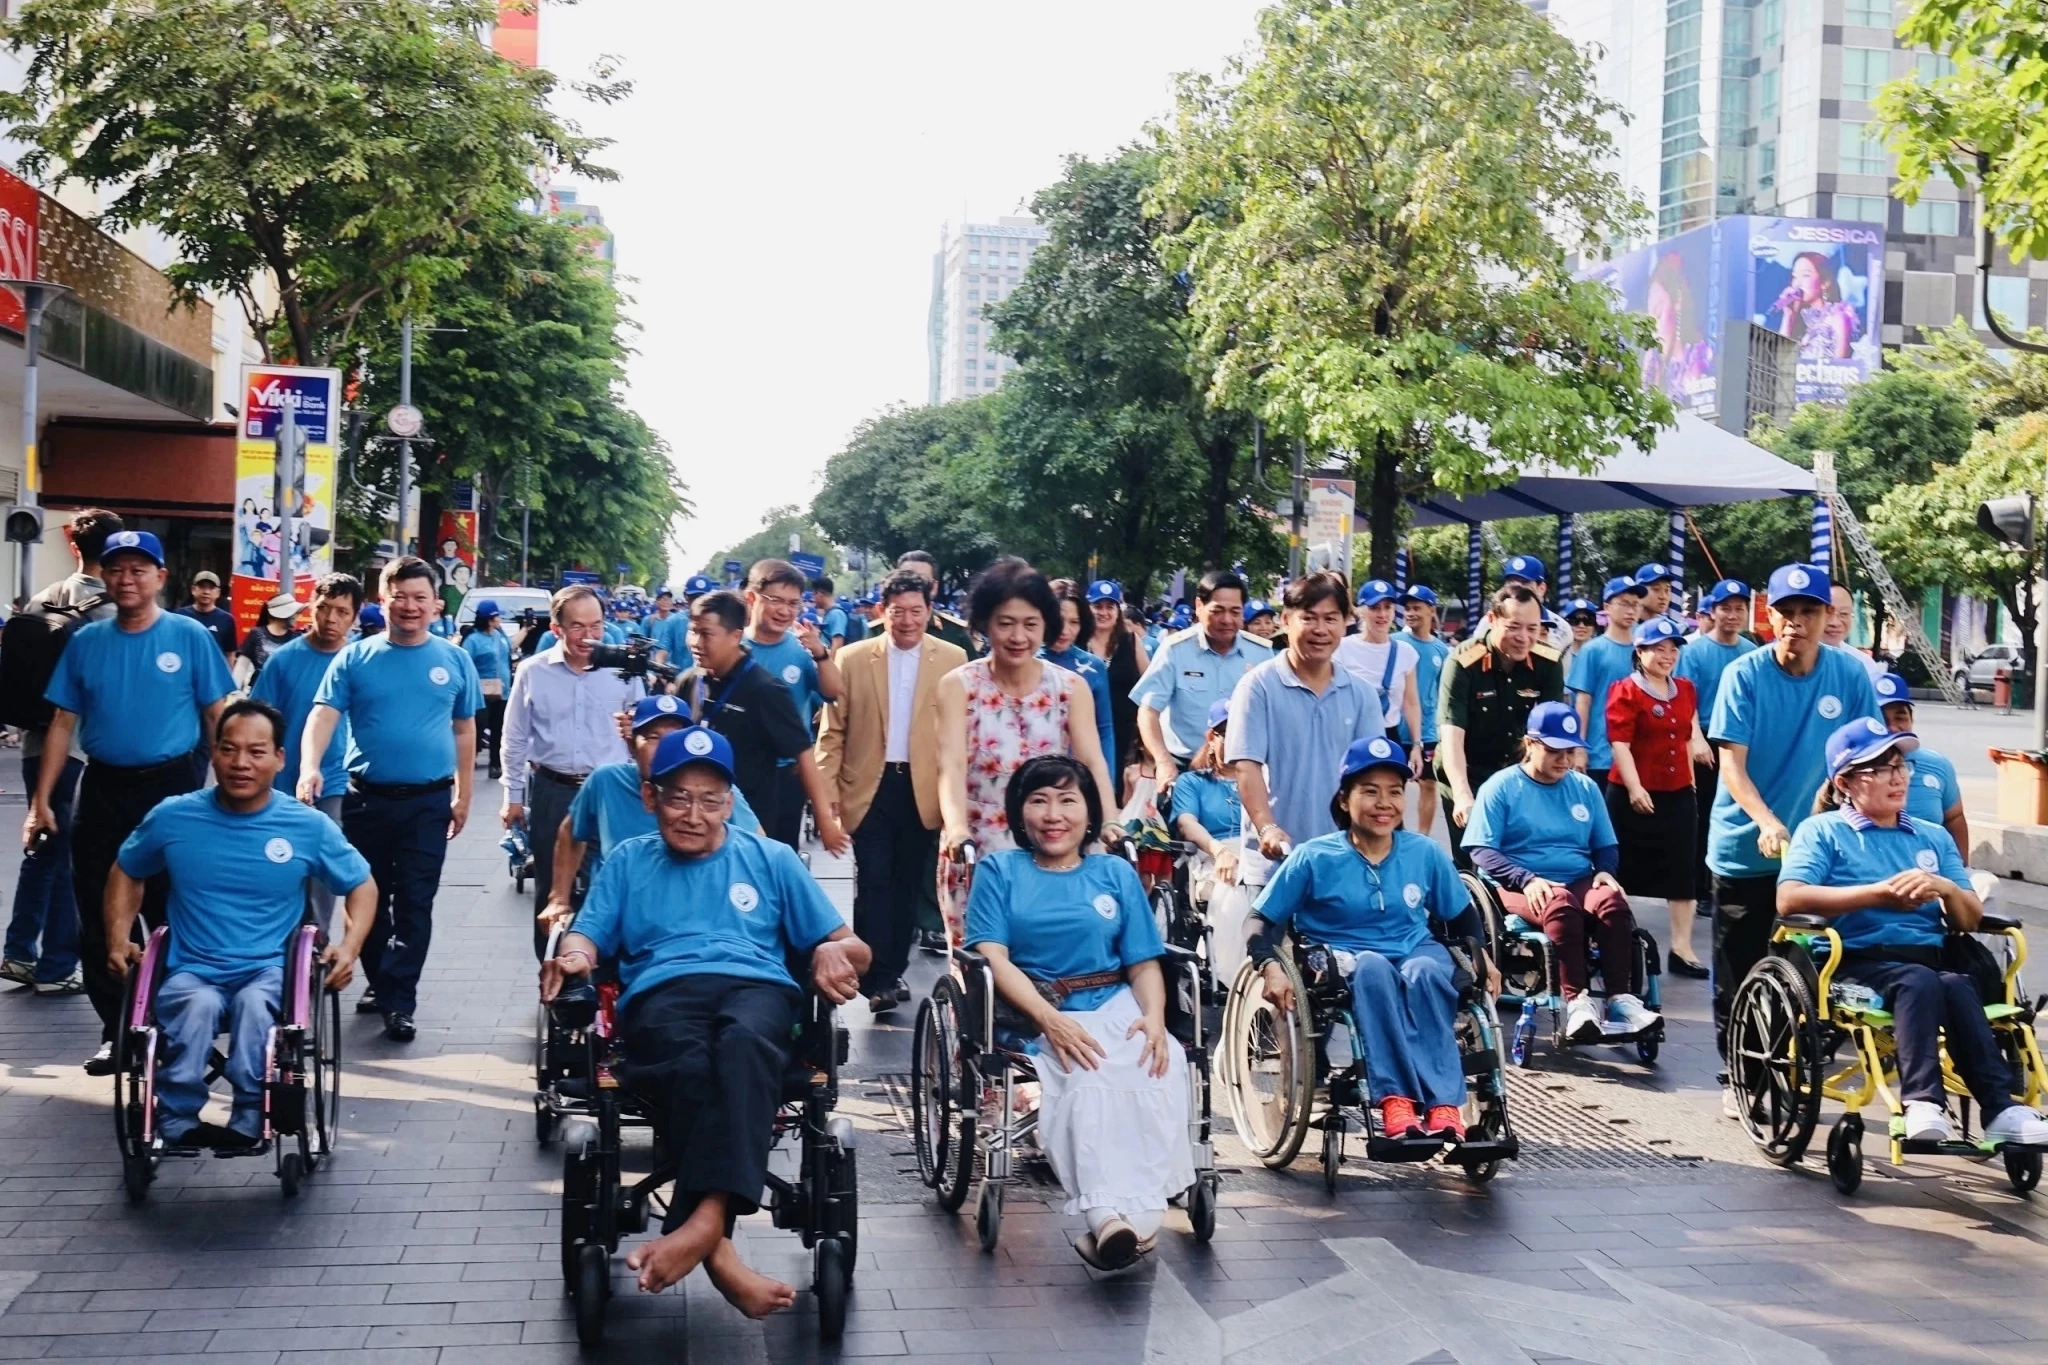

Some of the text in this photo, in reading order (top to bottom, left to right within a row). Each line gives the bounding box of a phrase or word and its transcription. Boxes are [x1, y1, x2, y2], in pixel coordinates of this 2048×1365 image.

[1788, 225, 1880, 245] JESSICA
[250, 379, 303, 408] Vikki
[302, 400, 327, 410] Bank
